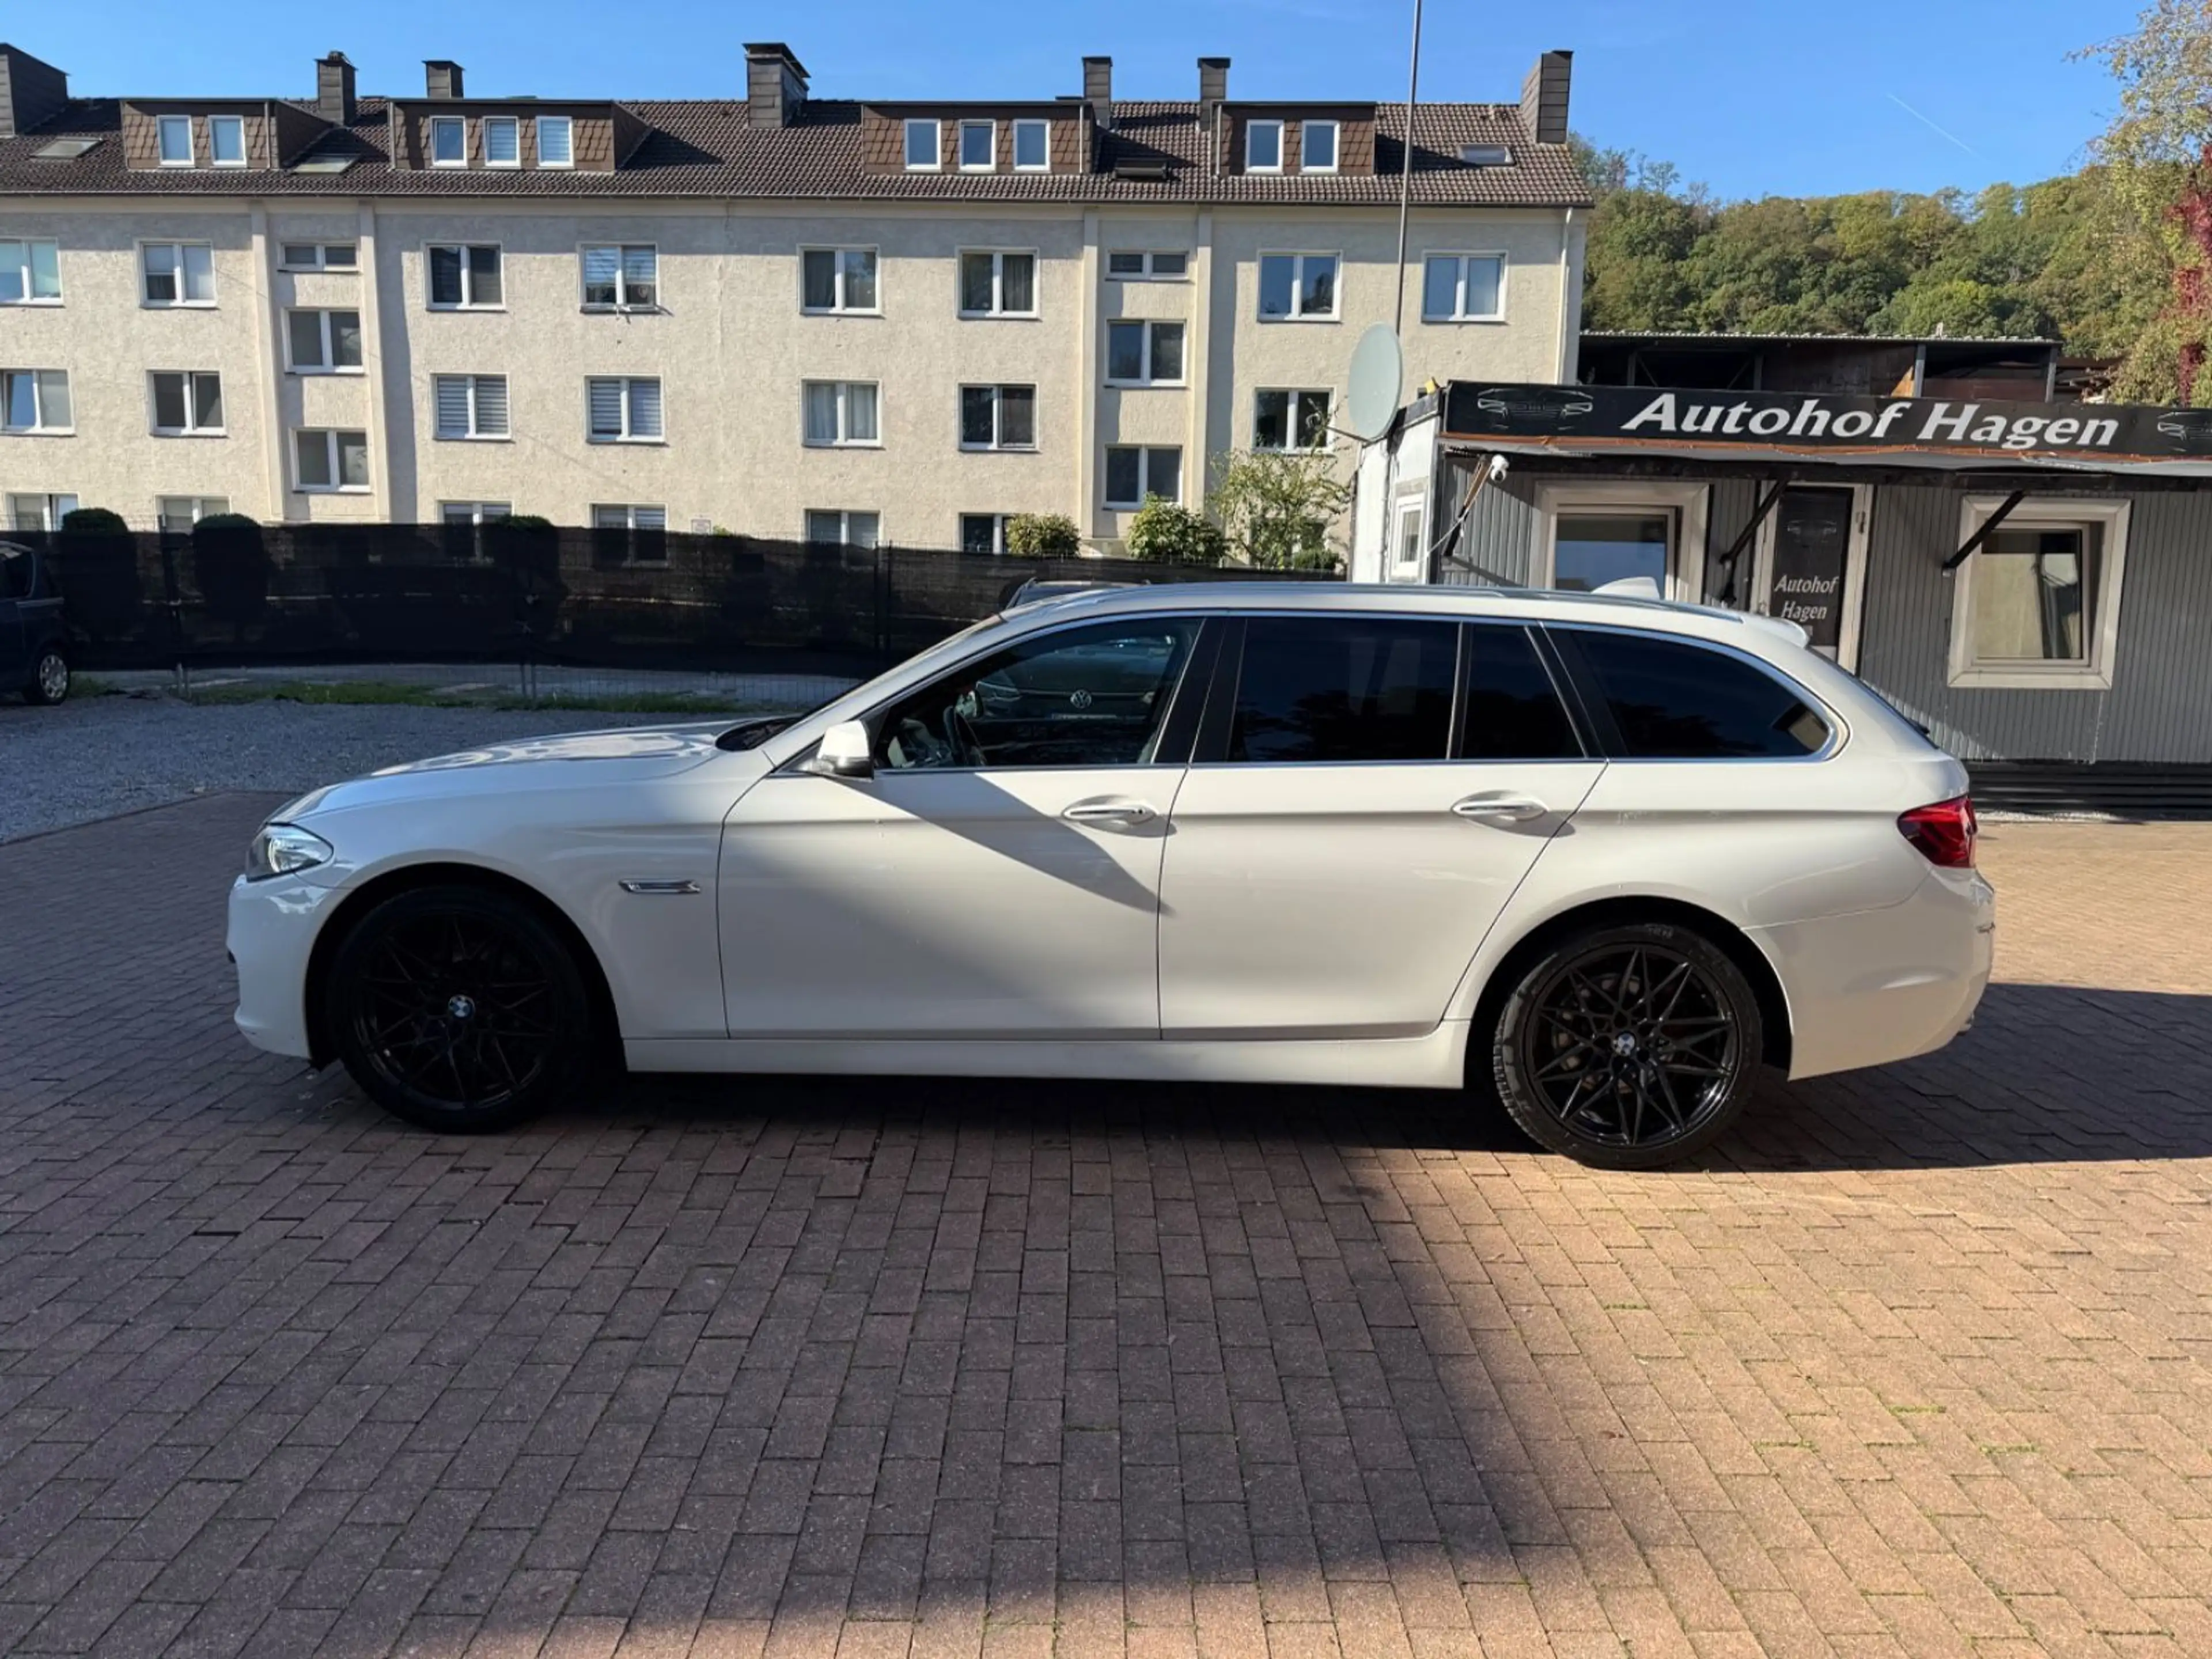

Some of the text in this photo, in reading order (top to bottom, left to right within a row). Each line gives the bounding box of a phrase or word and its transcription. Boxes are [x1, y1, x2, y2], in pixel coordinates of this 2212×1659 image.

[1620, 393, 2119, 450] Autohof Hagen
[1774, 575, 1839, 594] Autohof
[1781, 601, 1828, 622] Hagen
